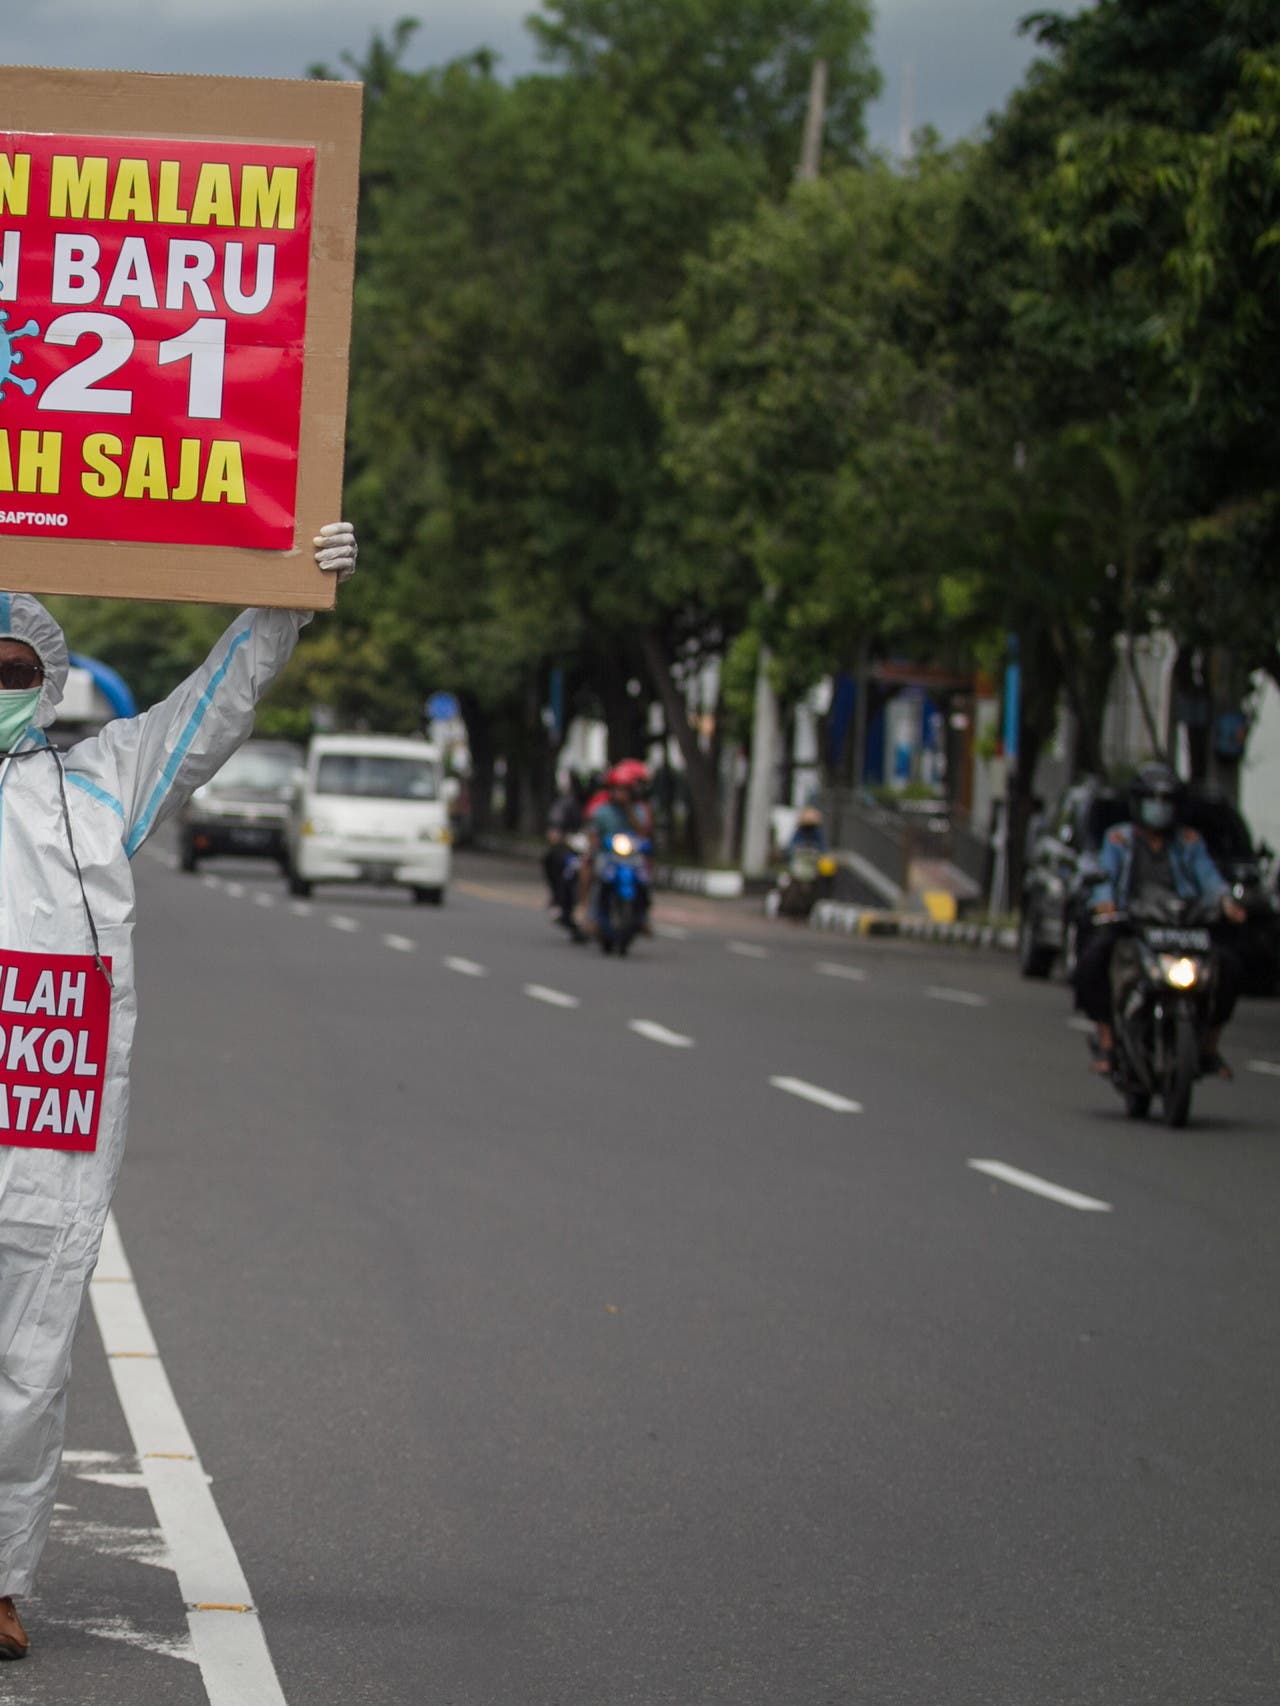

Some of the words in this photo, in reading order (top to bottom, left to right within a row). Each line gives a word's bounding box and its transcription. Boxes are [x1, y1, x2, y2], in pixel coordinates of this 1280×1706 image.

[49, 156, 298, 229] MALAM
[51, 233, 276, 314] BARU
[81, 433, 247, 503] SAJA
